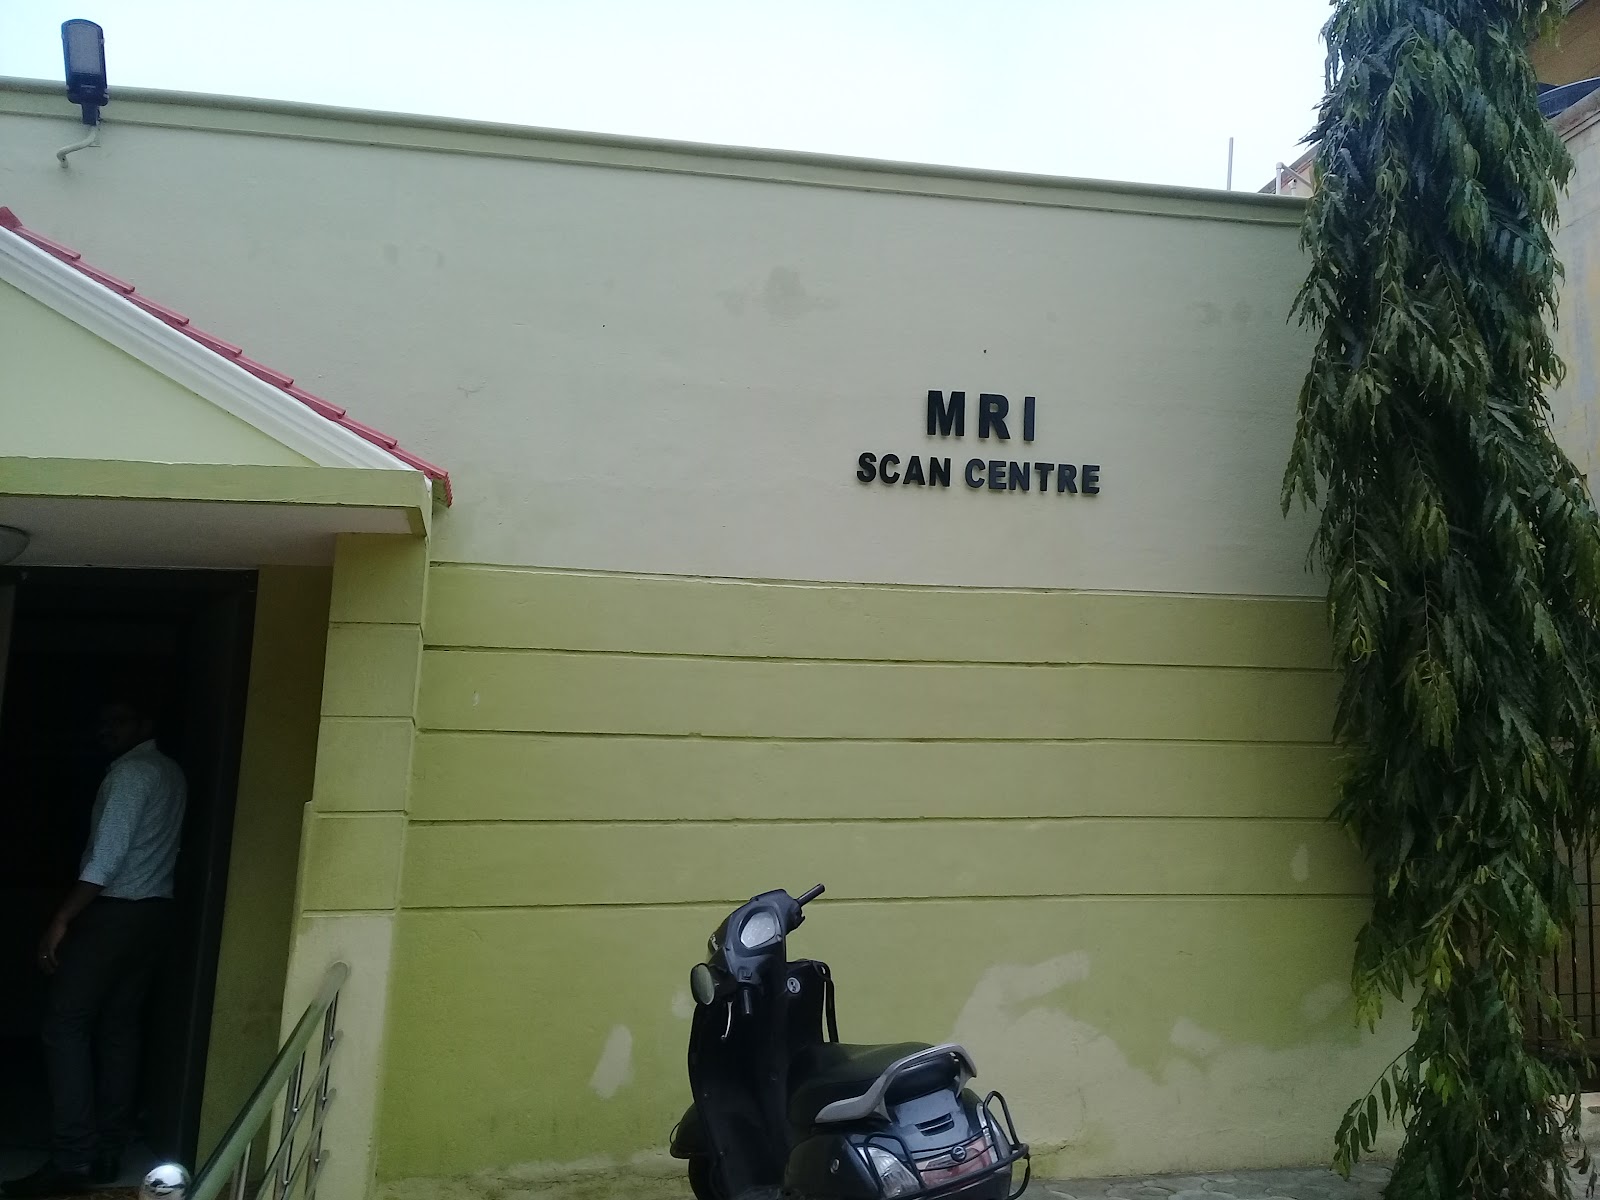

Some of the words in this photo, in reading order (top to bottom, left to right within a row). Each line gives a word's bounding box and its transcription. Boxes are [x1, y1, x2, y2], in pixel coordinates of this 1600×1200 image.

[926, 389, 1037, 444] MRI
[856, 452, 951, 488] SCAN
[964, 458, 1101, 496] CENTRE
